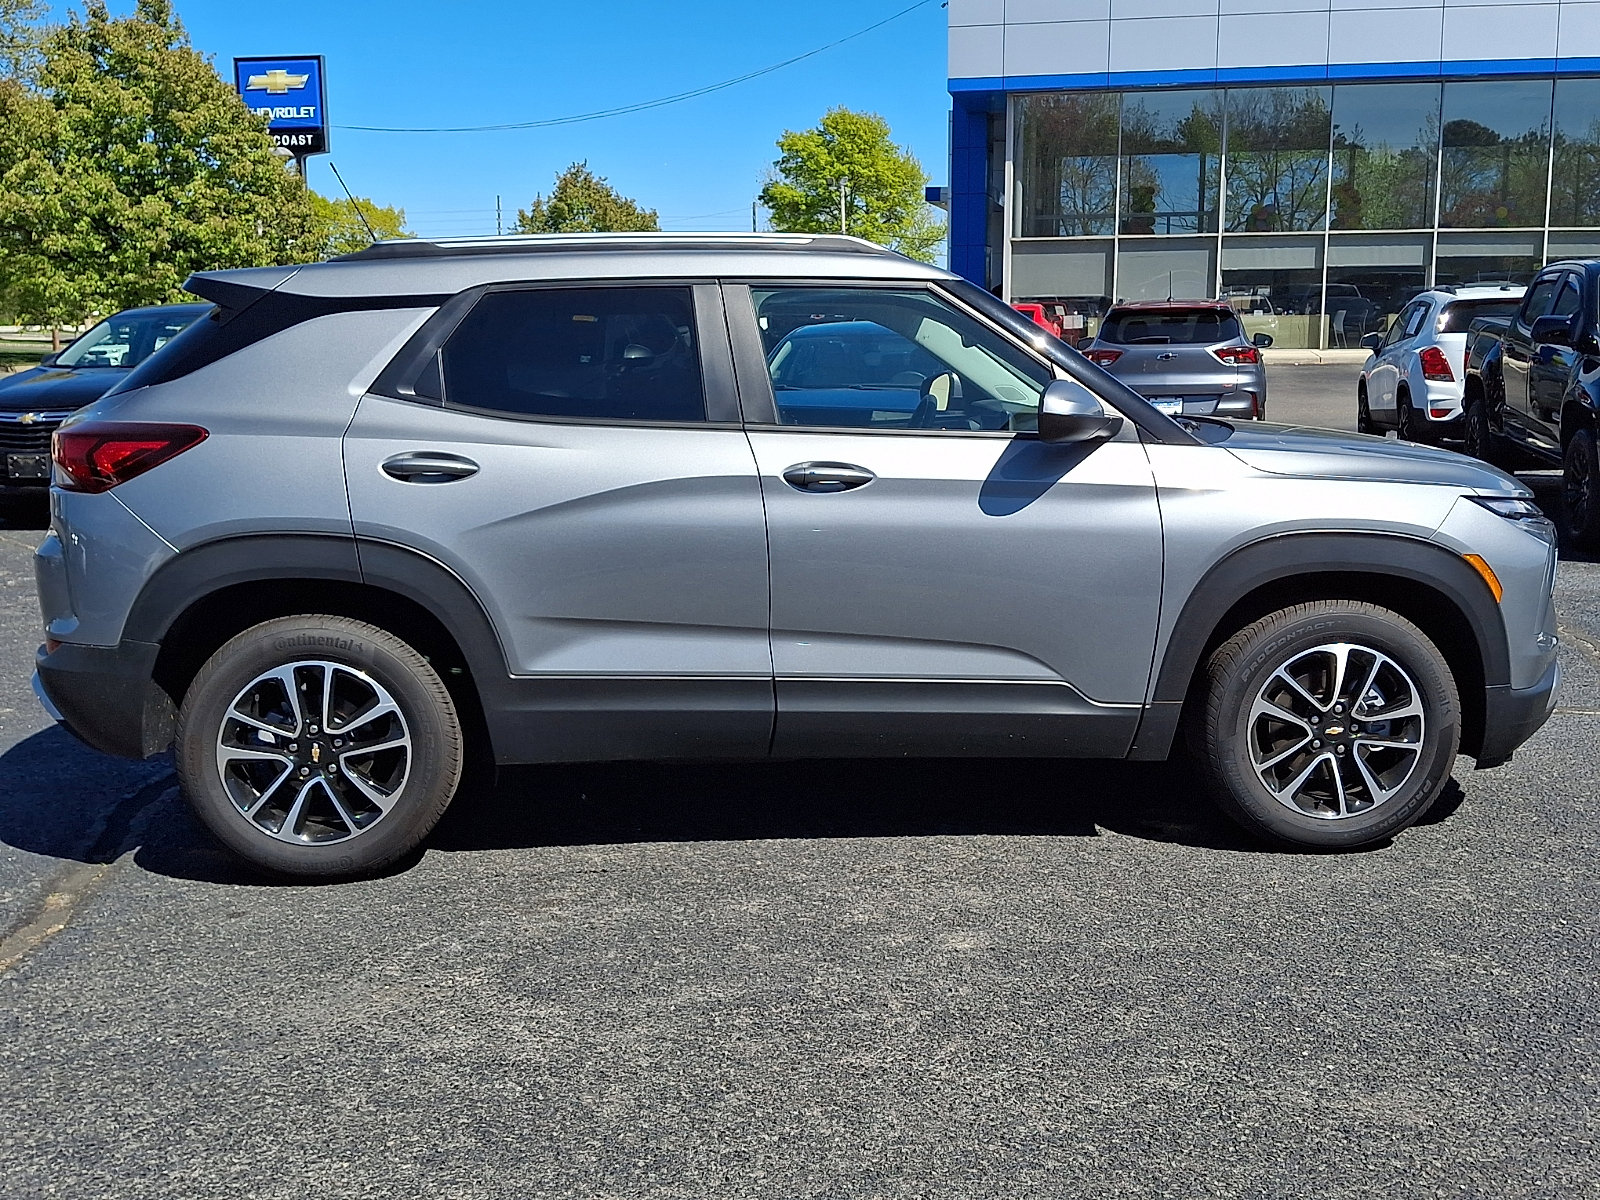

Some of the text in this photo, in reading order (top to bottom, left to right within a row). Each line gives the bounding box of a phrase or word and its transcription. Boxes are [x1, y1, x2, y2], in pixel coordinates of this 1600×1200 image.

[249, 106, 316, 119] HEVROLET
[273, 134, 313, 146] COAST
[273, 633, 354, 651] Continental
